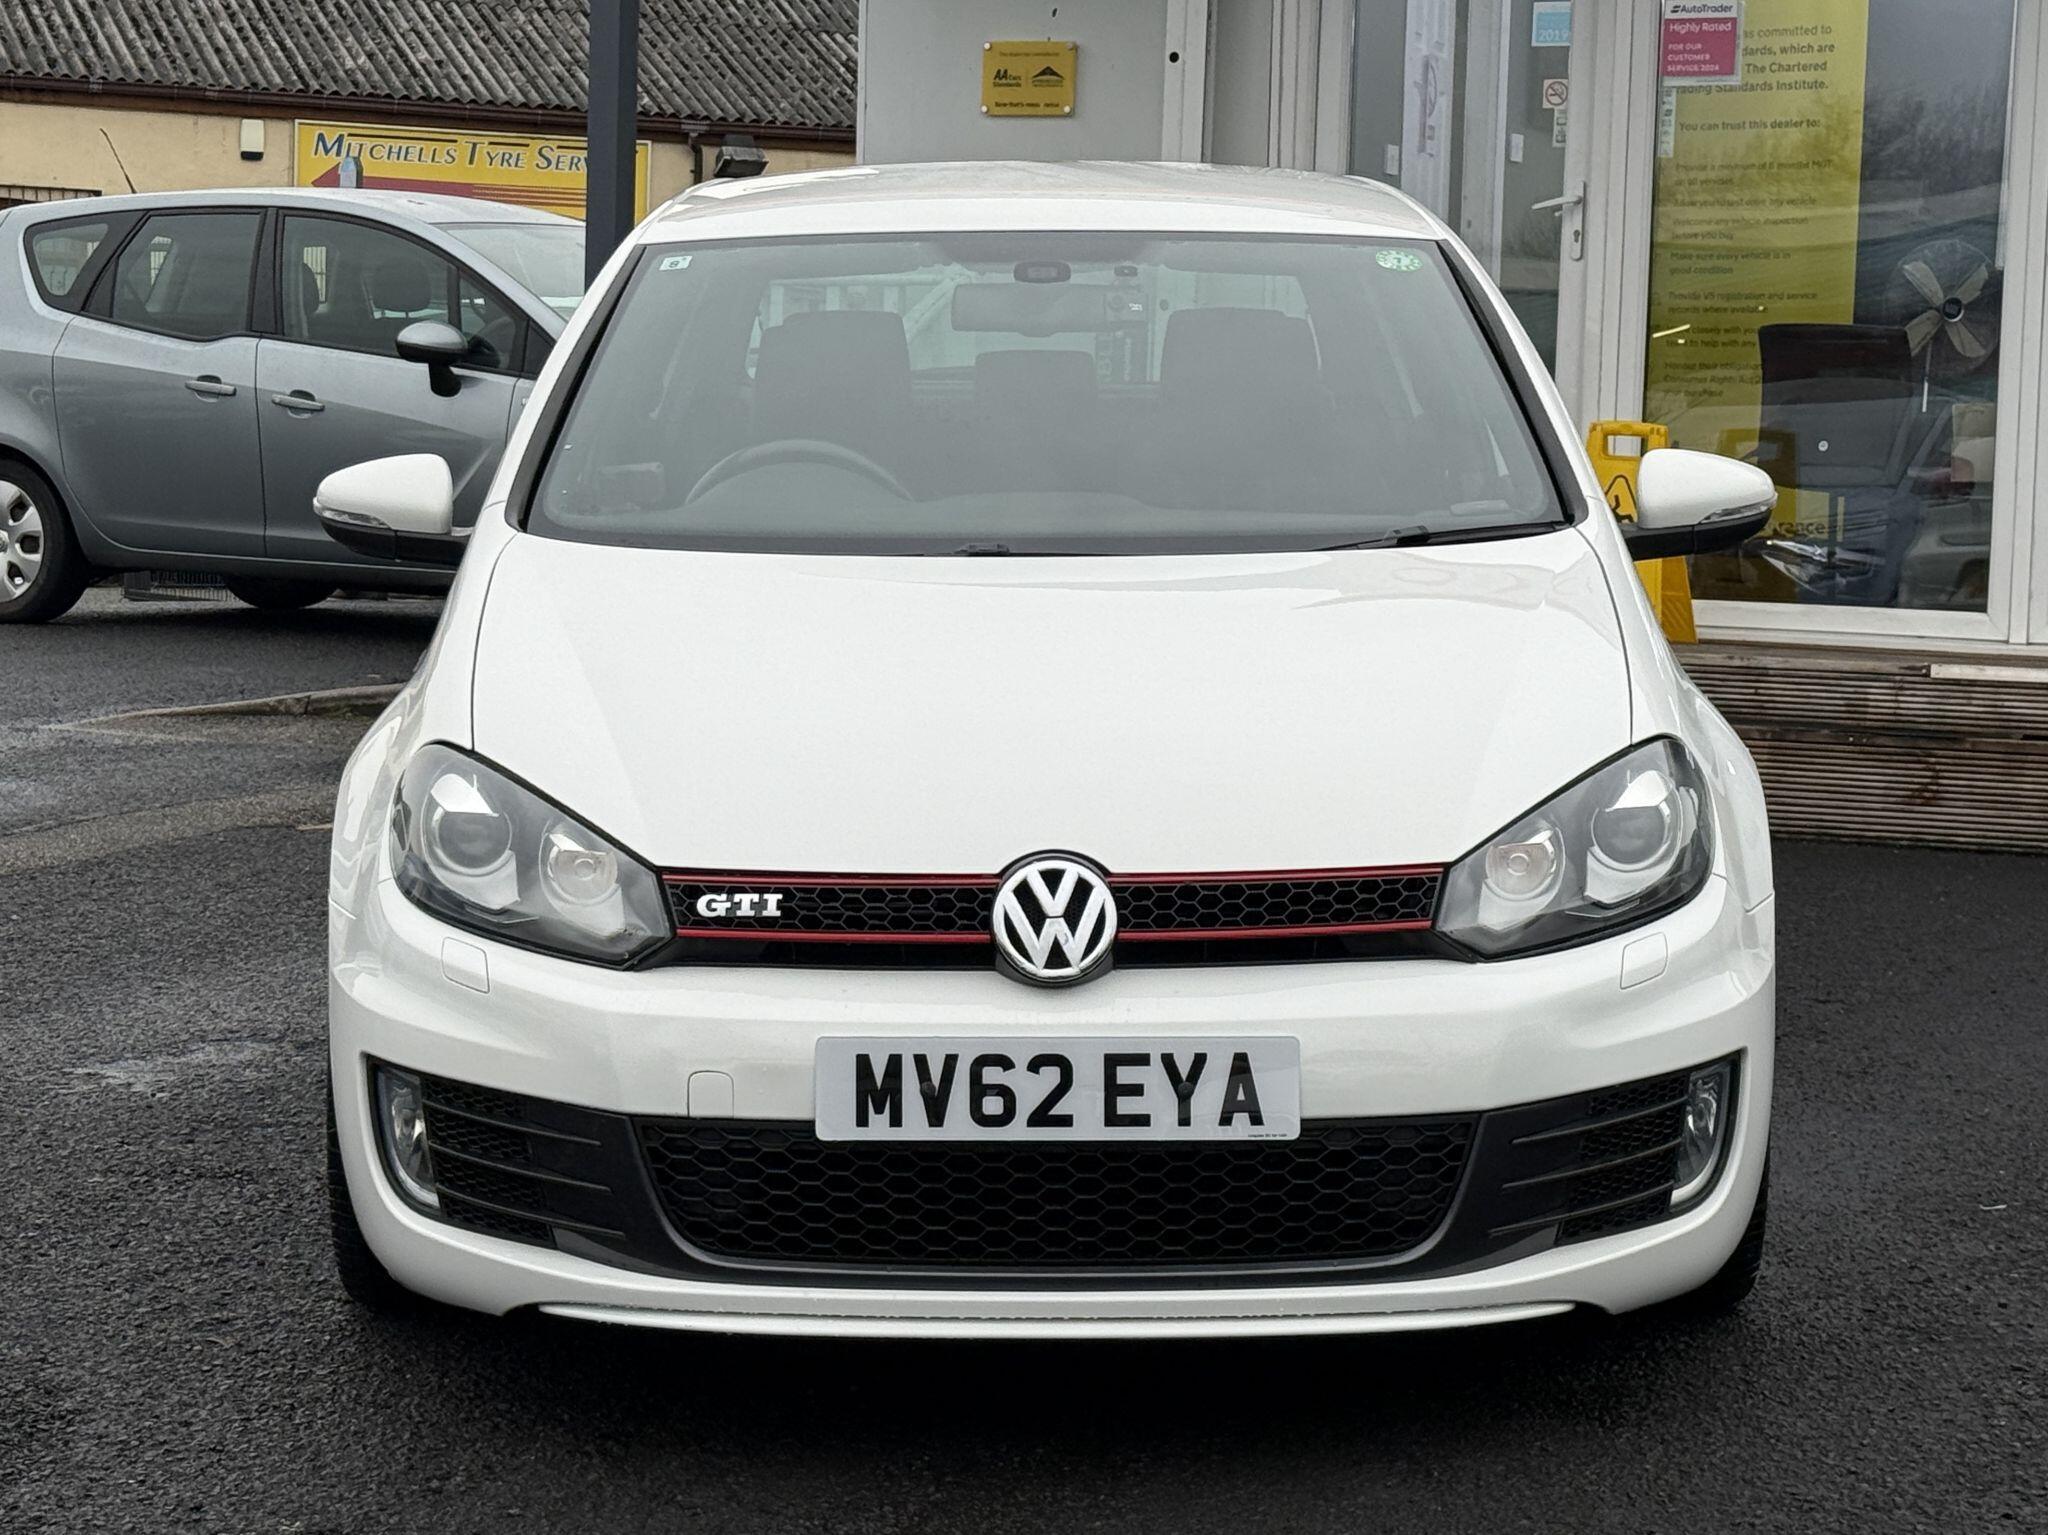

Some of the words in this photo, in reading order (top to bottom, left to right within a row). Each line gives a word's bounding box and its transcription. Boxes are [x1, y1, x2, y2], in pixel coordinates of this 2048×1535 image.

[1680, 4, 1733, 14] AutoTrader
[1669, 23, 1700, 34] Highly
[1702, 22, 1732, 32] Rated
[1757, 25, 1818, 38] committed
[1821, 25, 1832, 34] to
[1538, 29, 1570, 41] 2019
[1780, 43, 1814, 54] which
[1816, 44, 1835, 53] are
[1667, 53, 1710, 61] CUSTOMER
[1667, 64, 1699, 72] SERVICE
[1745, 63, 1767, 74] The
[1769, 61, 1828, 73] Chartered
[1776, 80, 1829, 91] Institute.
[1679, 121, 1698, 131] You
[1722, 120, 1746, 130] trust
[1749, 119, 1768, 129] this
[1770, 118, 1804, 129] dealer
[313, 132, 457, 165] MITCHELLS
[465, 141, 526, 168] TYRE
[696, 892, 783, 918] GTI
[855, 1052, 1074, 1128] MV62
[1104, 1052, 1264, 1128] EYA
